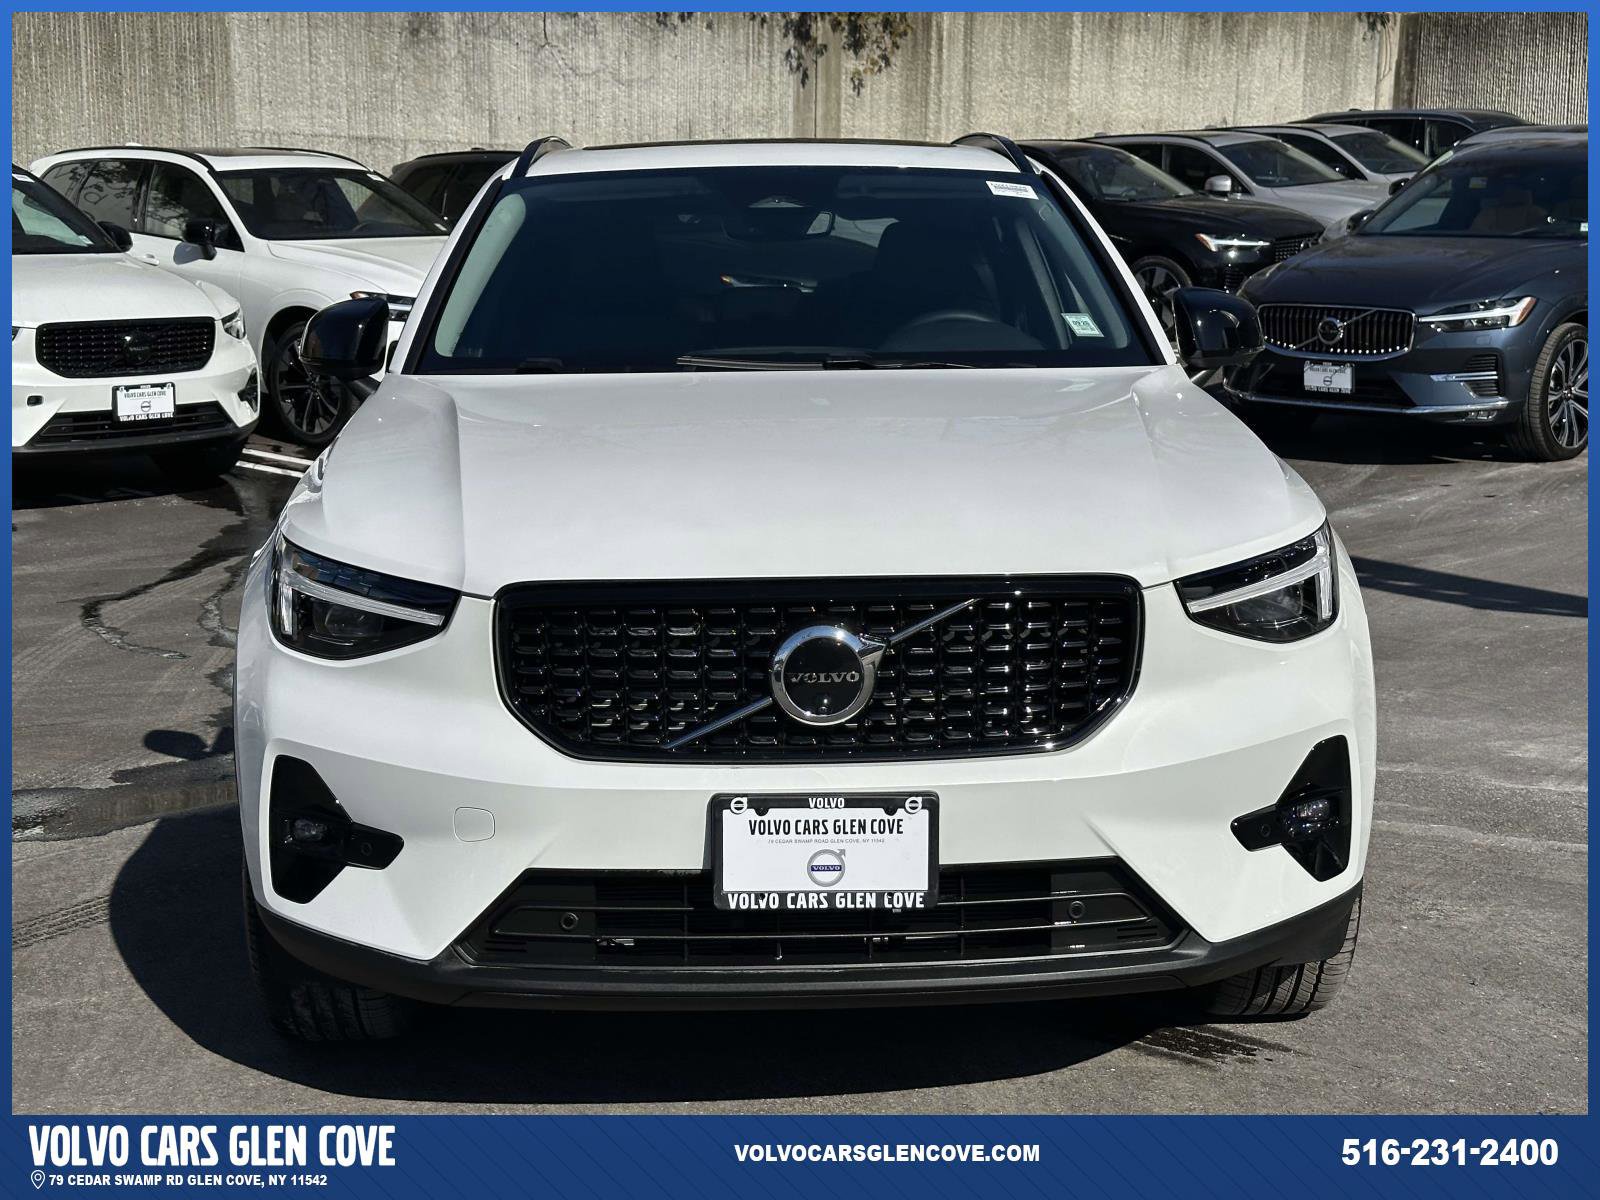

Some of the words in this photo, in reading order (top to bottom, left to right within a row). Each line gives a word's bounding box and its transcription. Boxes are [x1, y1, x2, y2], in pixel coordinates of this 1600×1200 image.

[785, 672, 860, 683] VOLVO
[808, 797, 845, 809] VOLVO
[749, 819, 791, 835] VOLVO
[795, 819, 829, 835] CARS
[833, 818, 867, 835] GLEN
[870, 818, 904, 835] COVE
[728, 893, 779, 909] VOLVO
[787, 893, 828, 909] CARS
[836, 893, 876, 908] GLEN
[884, 892, 924, 908] COVE
